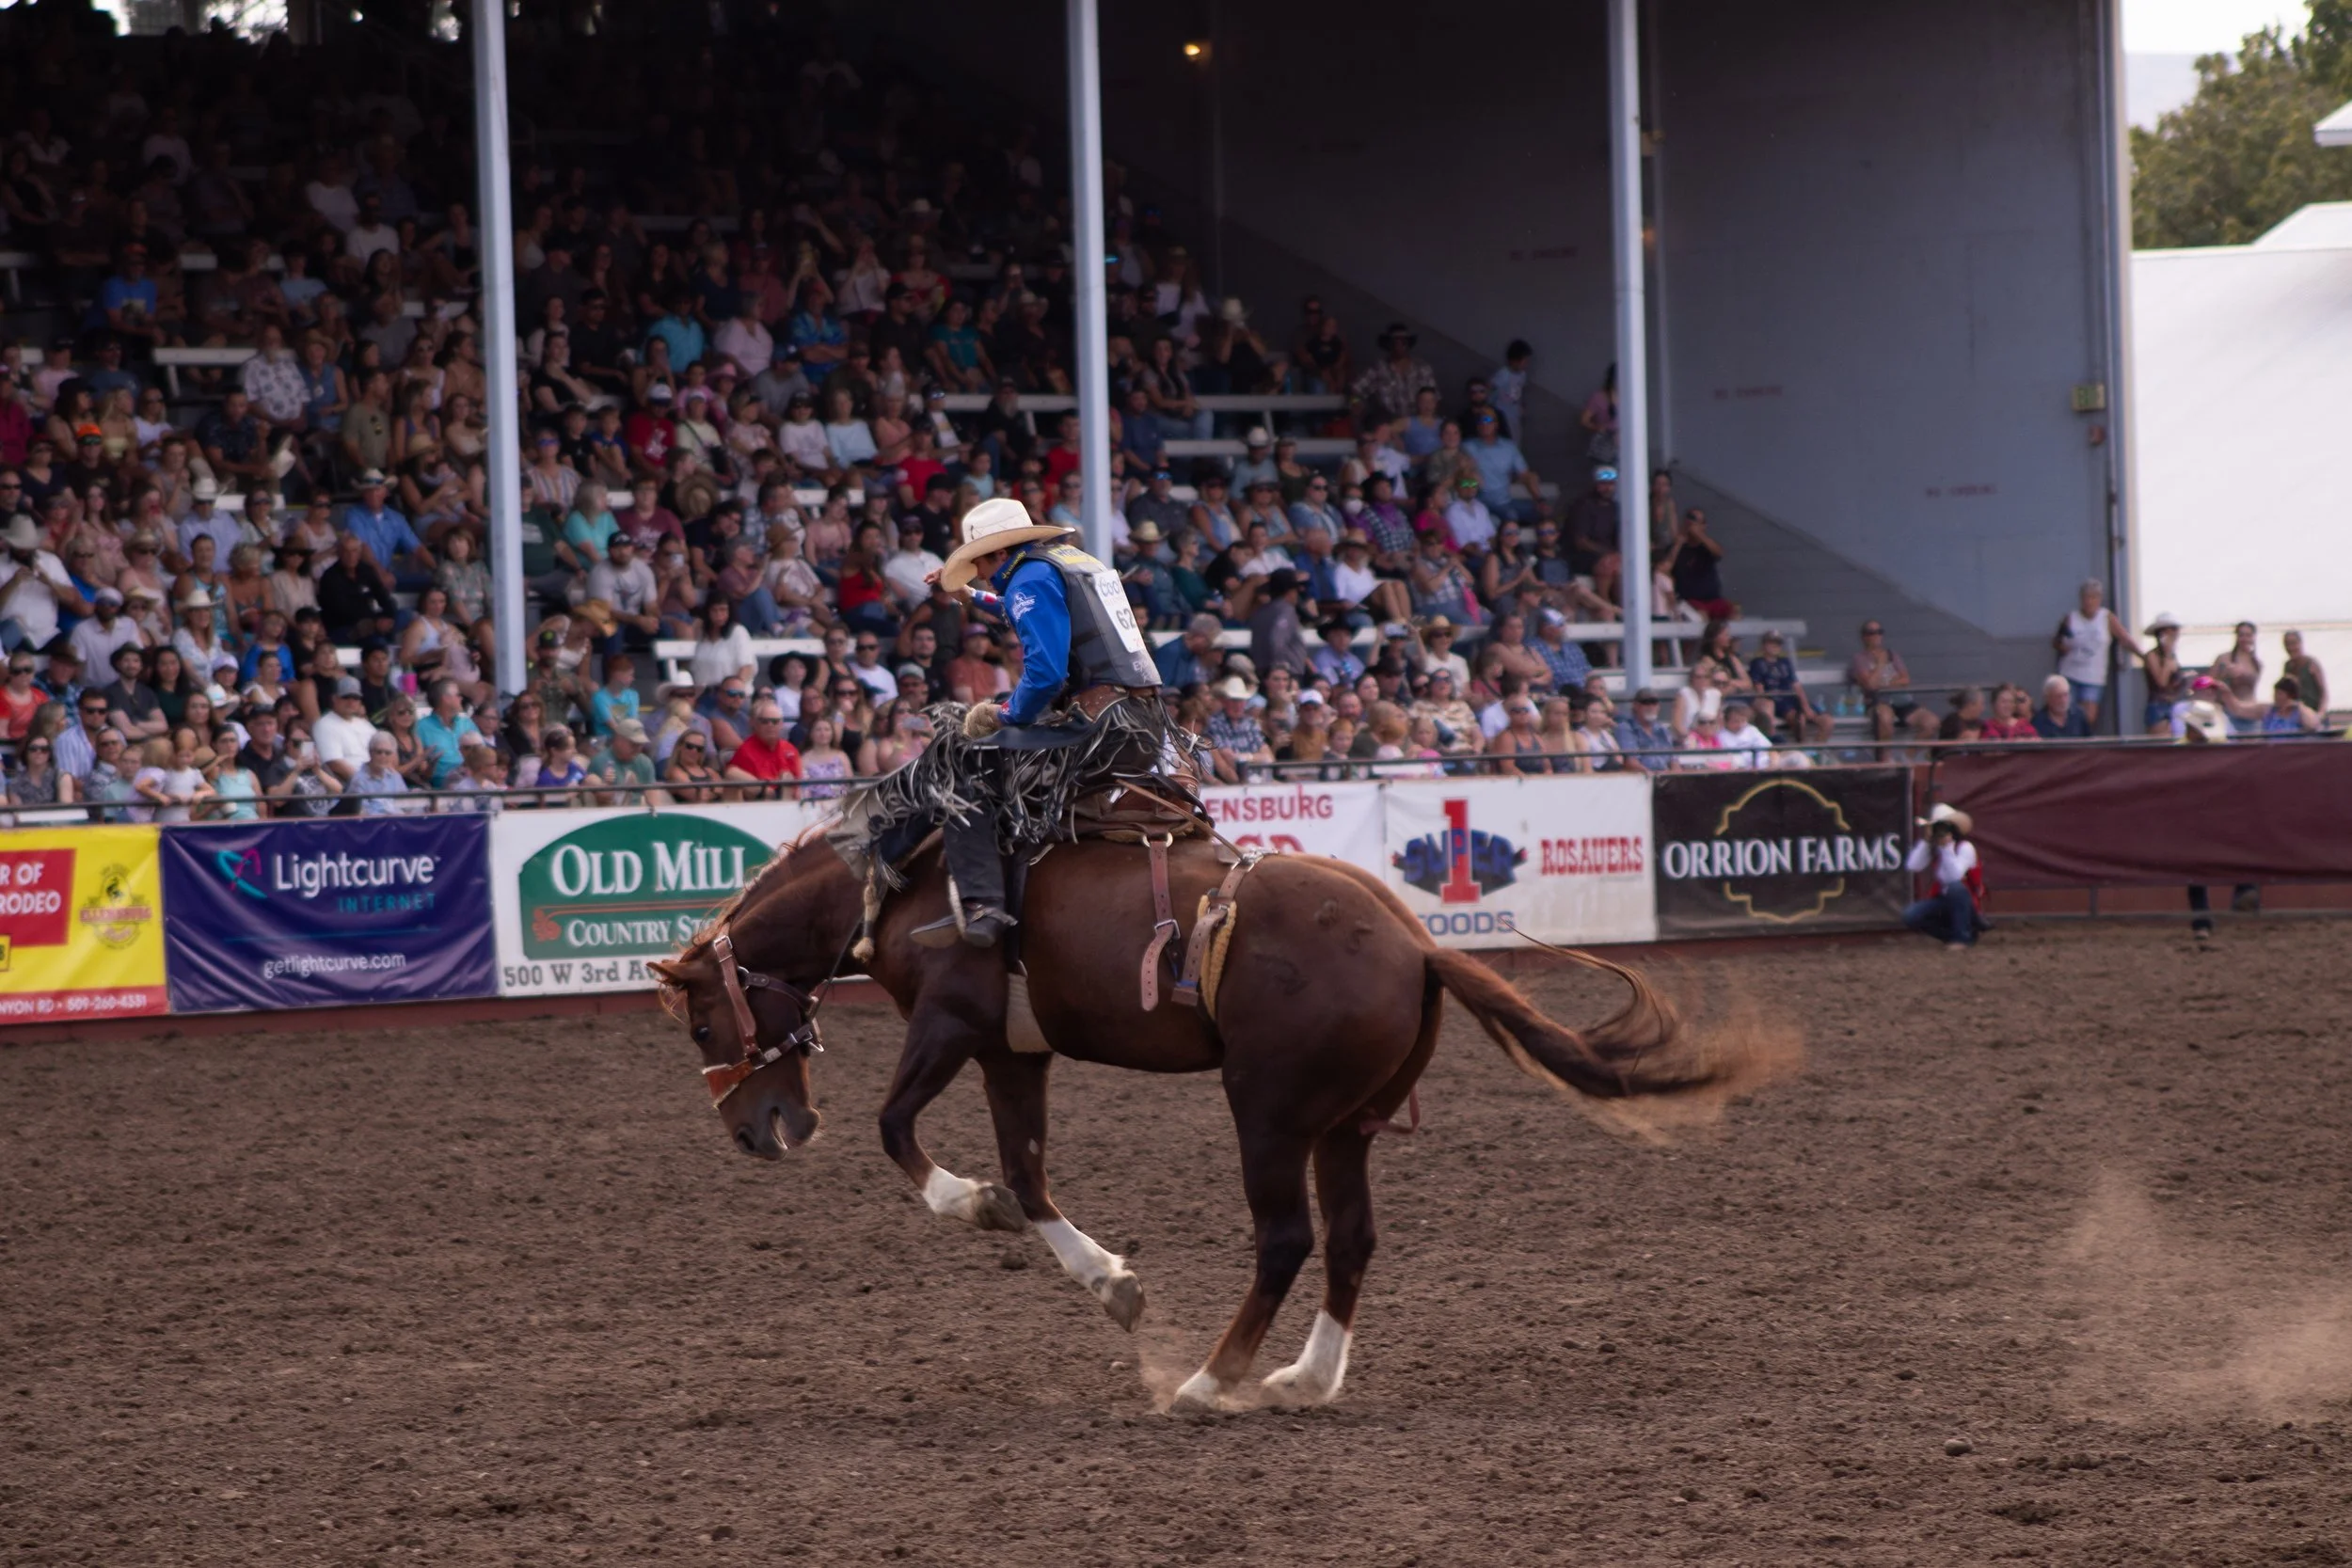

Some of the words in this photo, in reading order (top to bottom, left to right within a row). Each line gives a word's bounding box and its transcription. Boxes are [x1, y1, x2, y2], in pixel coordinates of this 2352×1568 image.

[550, 844, 643, 896] OLD
[653, 841, 746, 893] MILL
[1405, 828, 1516, 882] SUPER
[1539, 836, 1644, 874] ROSAUERS
[1662, 837, 1792, 879] ORRION
[1799, 833, 1902, 874] FARMS
[16, 862, 45, 886] OF
[275, 852, 435, 898] Lightcurve
[338, 893, 436, 913] INTERNET
[567, 919, 672, 946] COUNTRY
[1417, 911, 1516, 936] OODS
[263, 952, 406, 979] getlightcurve.com
[504, 965, 543, 987] 500
[550, 964, 574, 984] W
[581, 961, 619, 983] 3rd
